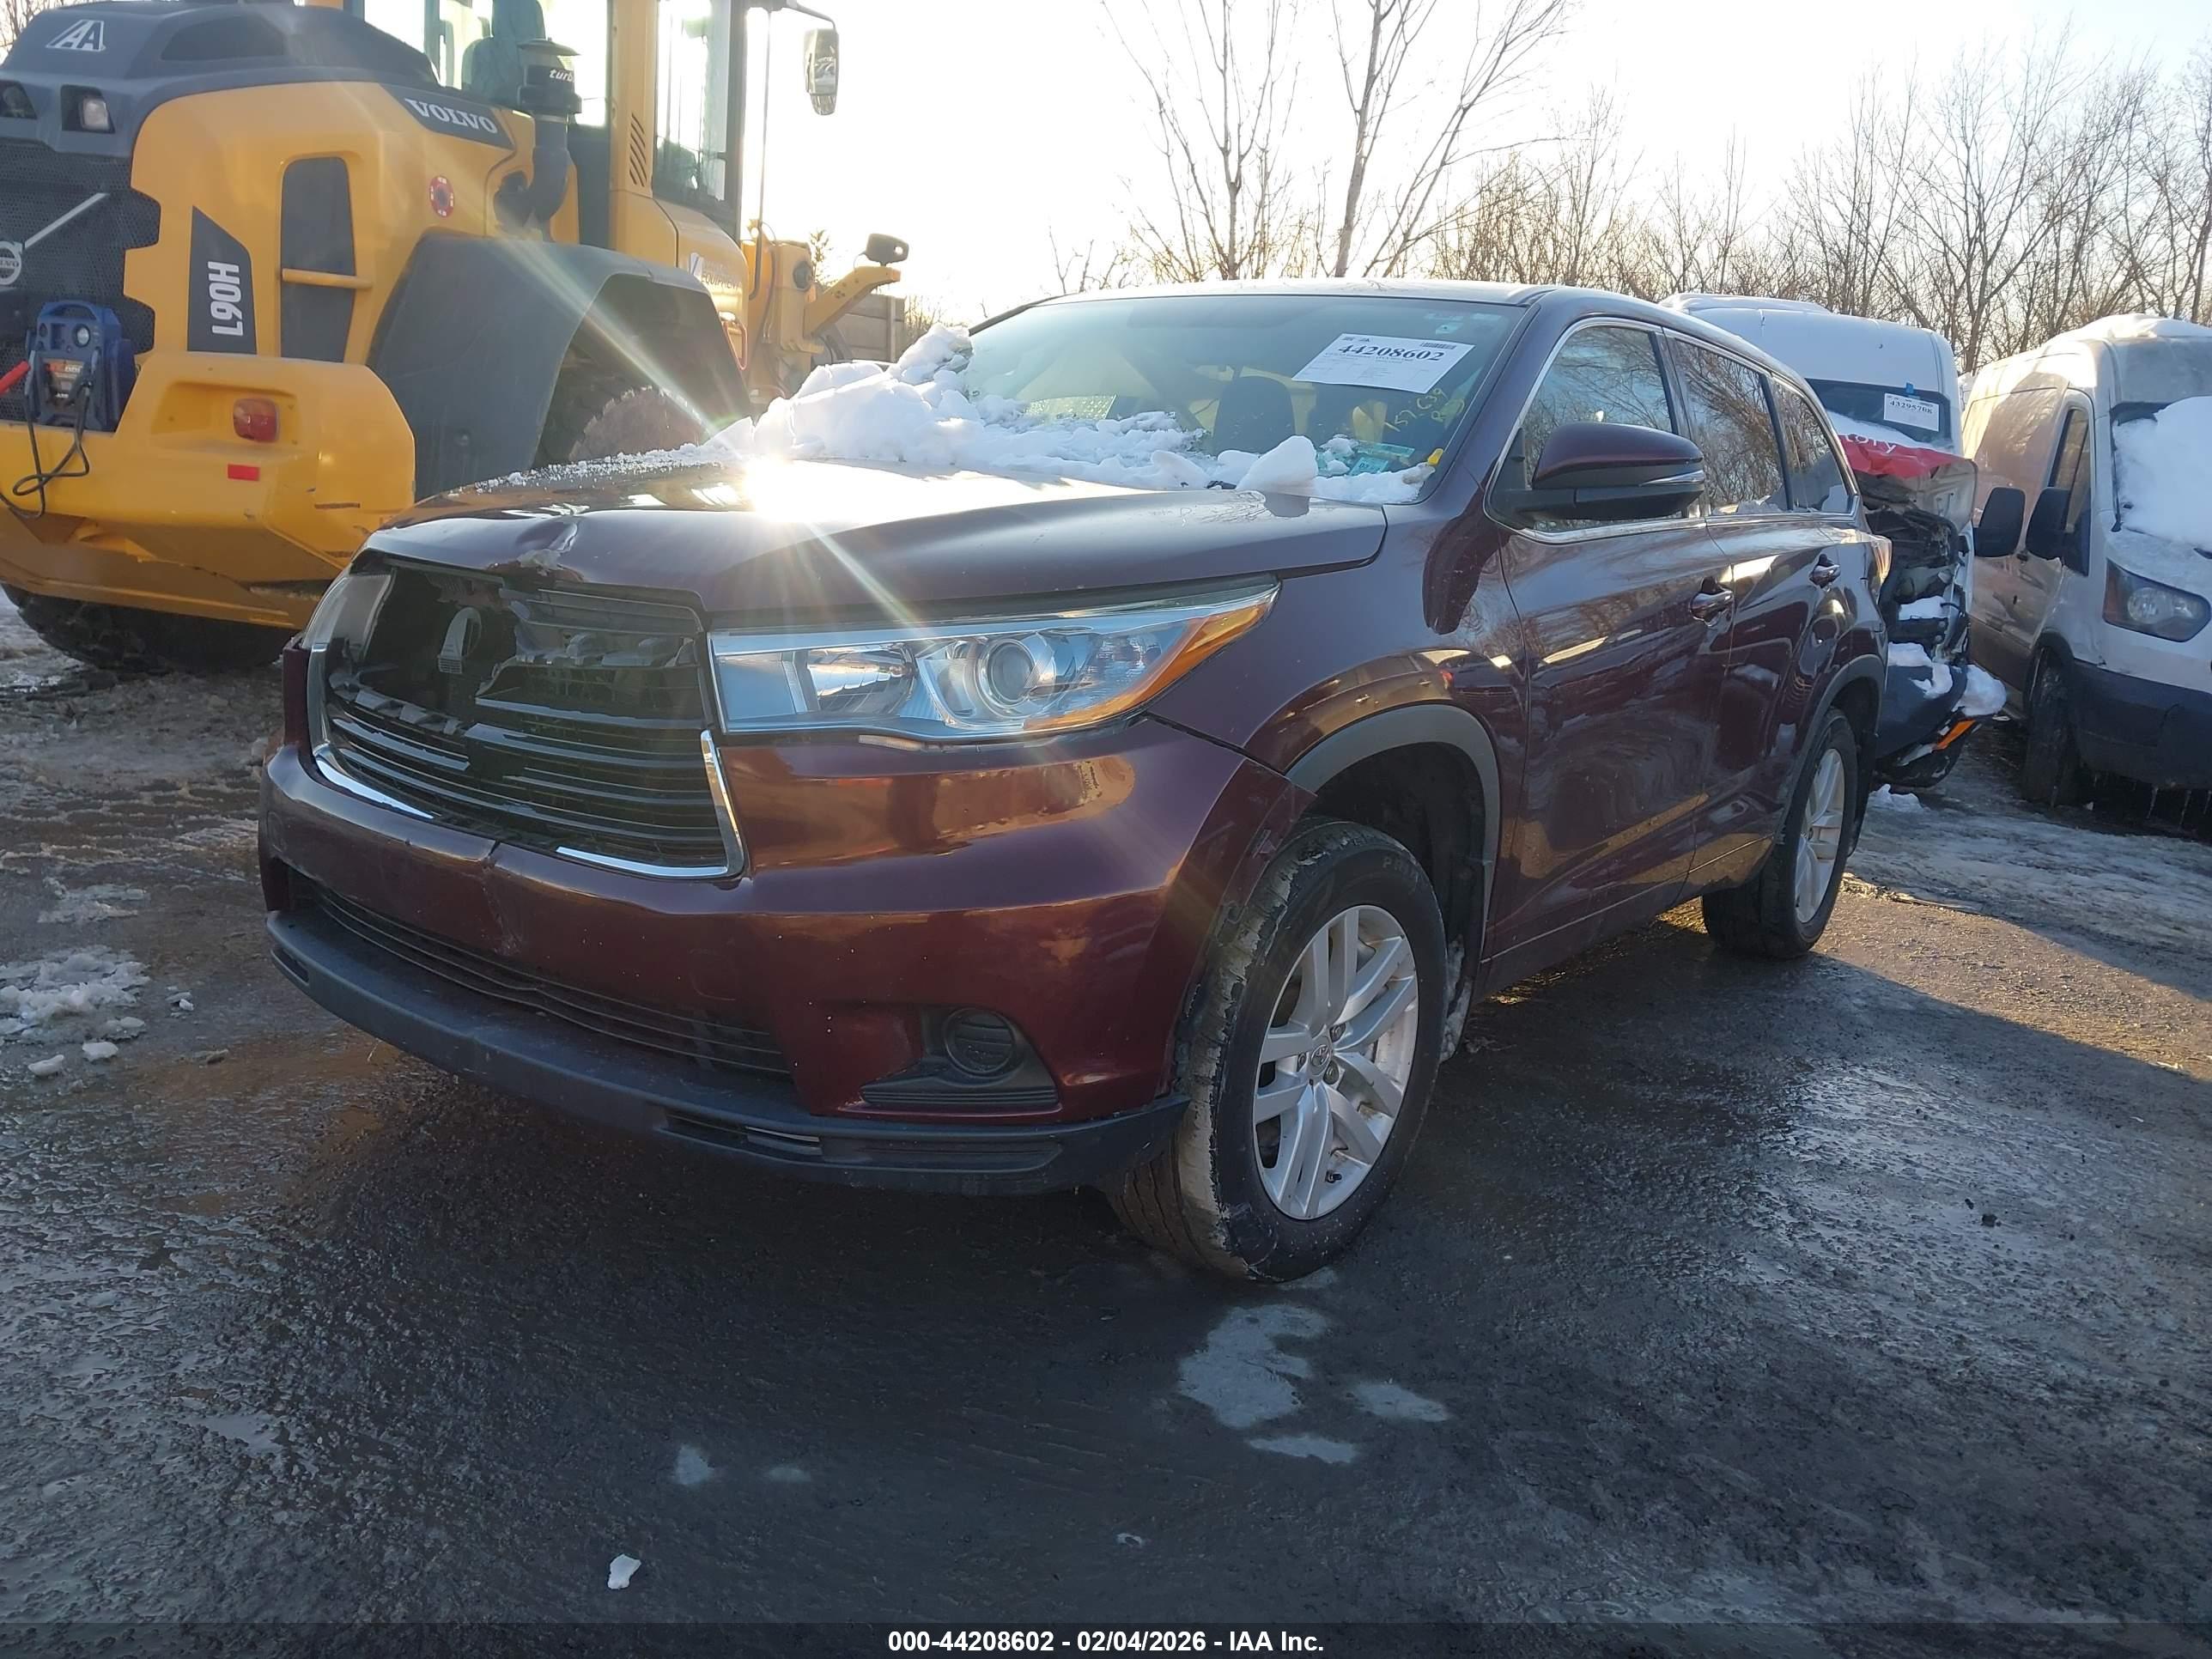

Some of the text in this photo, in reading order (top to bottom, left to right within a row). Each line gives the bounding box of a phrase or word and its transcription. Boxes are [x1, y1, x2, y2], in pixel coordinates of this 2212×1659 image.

[550, 69, 574, 82] turb
[404, 98, 498, 134] VOLVO
[207, 260, 244, 337] L90H
[1338, 344, 1444, 361] 44208602
